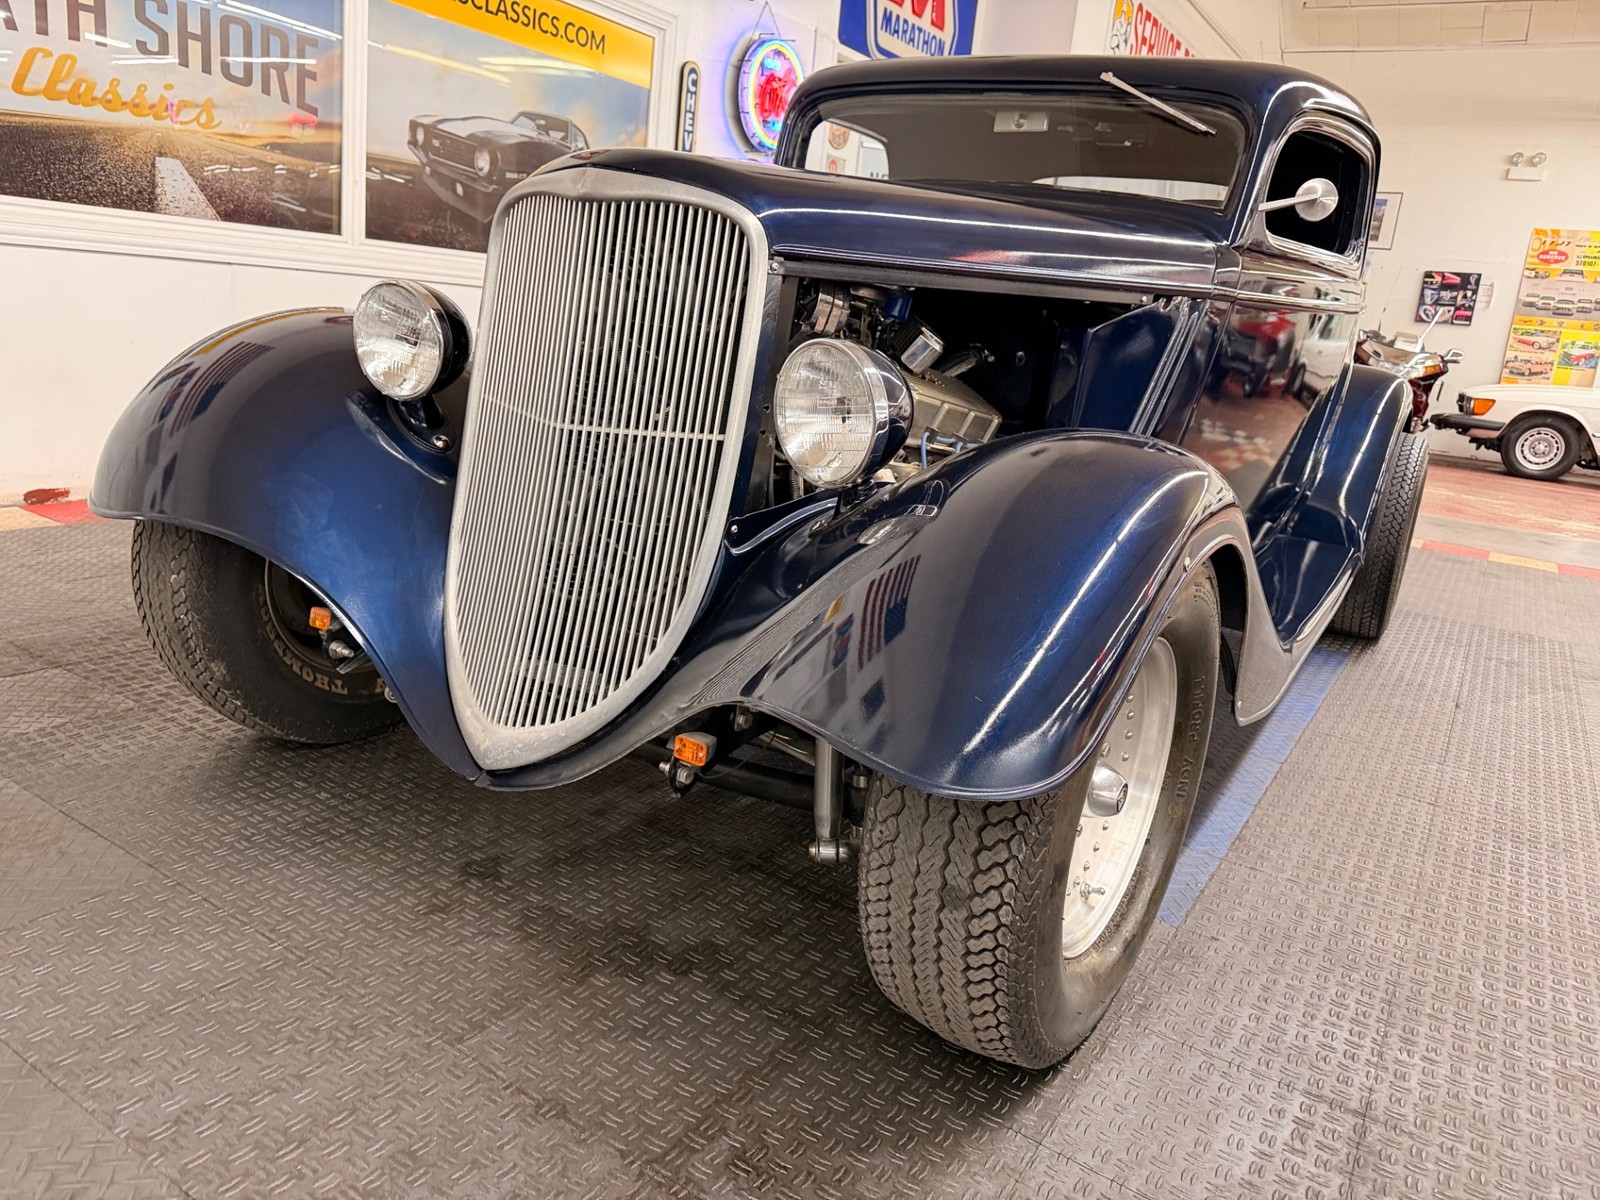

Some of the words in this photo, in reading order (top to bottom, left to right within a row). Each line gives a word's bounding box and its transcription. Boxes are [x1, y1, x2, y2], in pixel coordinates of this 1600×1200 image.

[135, 0, 319, 117] SHORE
[880, 7, 946, 56] MARATHON
[11, 47, 222, 130] Classics
